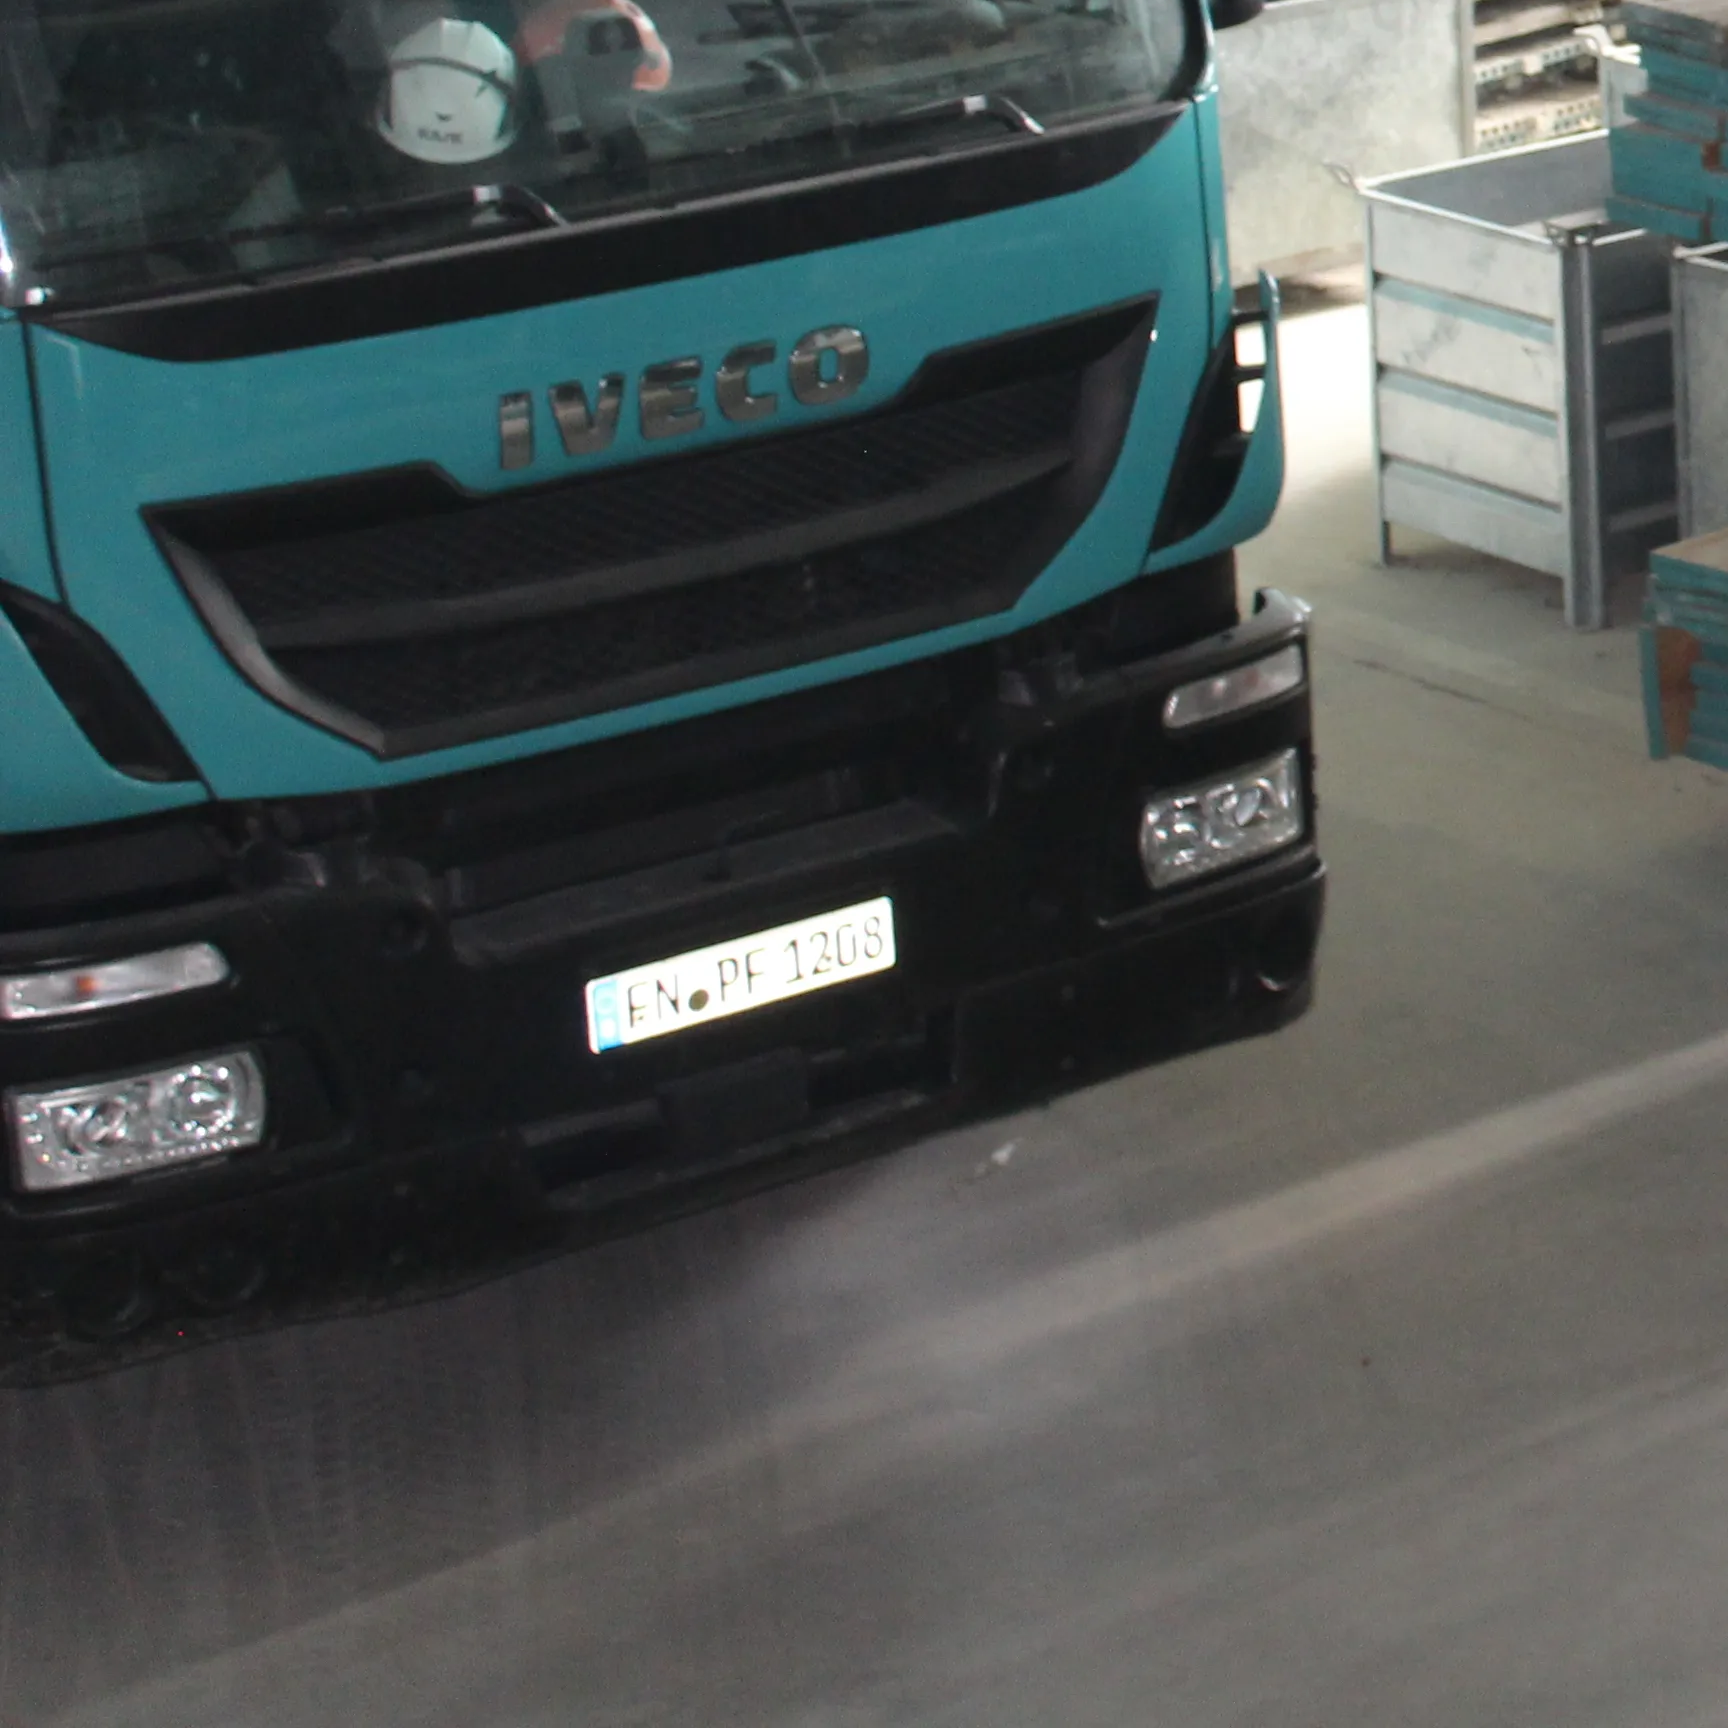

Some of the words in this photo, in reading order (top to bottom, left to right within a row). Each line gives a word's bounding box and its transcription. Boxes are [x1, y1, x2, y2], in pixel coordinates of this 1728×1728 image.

[499, 323, 870, 470] IVECO
[627, 974, 680, 1028] FN
[717, 948, 764, 1001] PF
[783, 916, 883, 984] 1208
